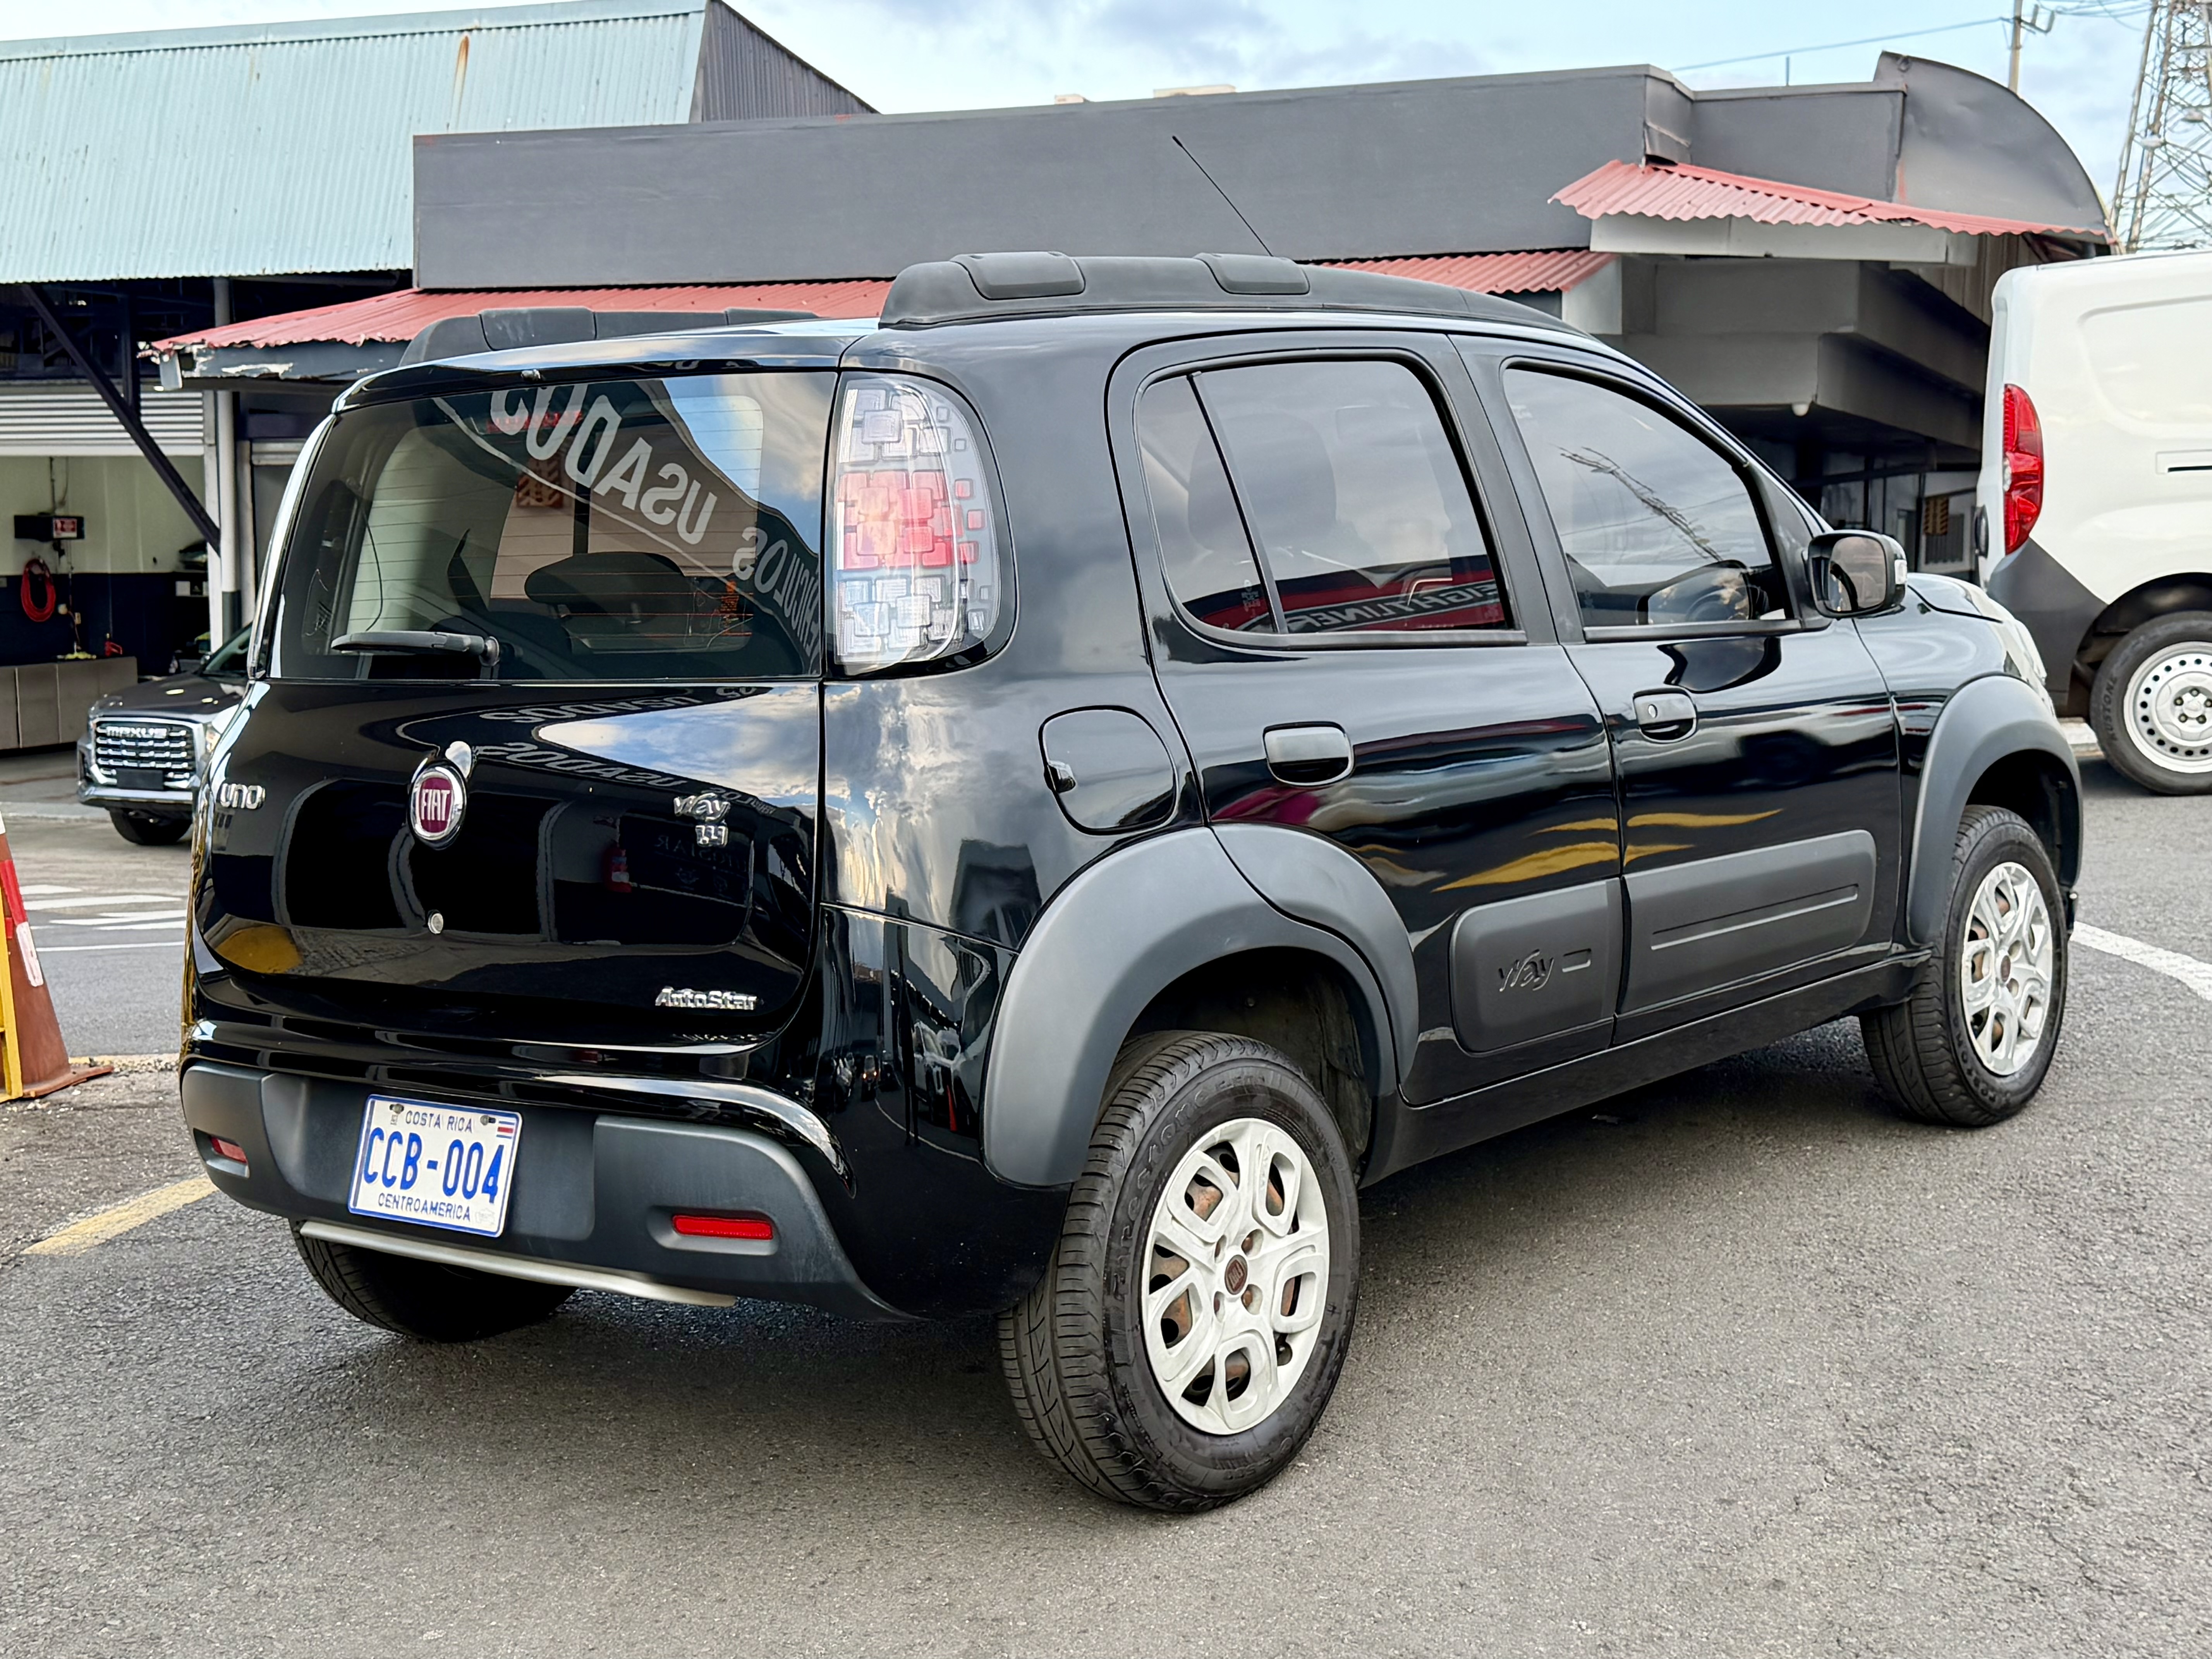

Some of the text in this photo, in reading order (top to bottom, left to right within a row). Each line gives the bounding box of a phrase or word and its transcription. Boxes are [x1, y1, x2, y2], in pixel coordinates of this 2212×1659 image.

[421, 788, 451, 821] FIAT
[655, 986, 757, 1010] AutoStar
[405, 1110, 441, 1129] COSTA
[447, 1115, 473, 1133] RICA
[363, 1127, 505, 1204] CCB-004
[378, 1192, 471, 1221] CENTROAMERICA
